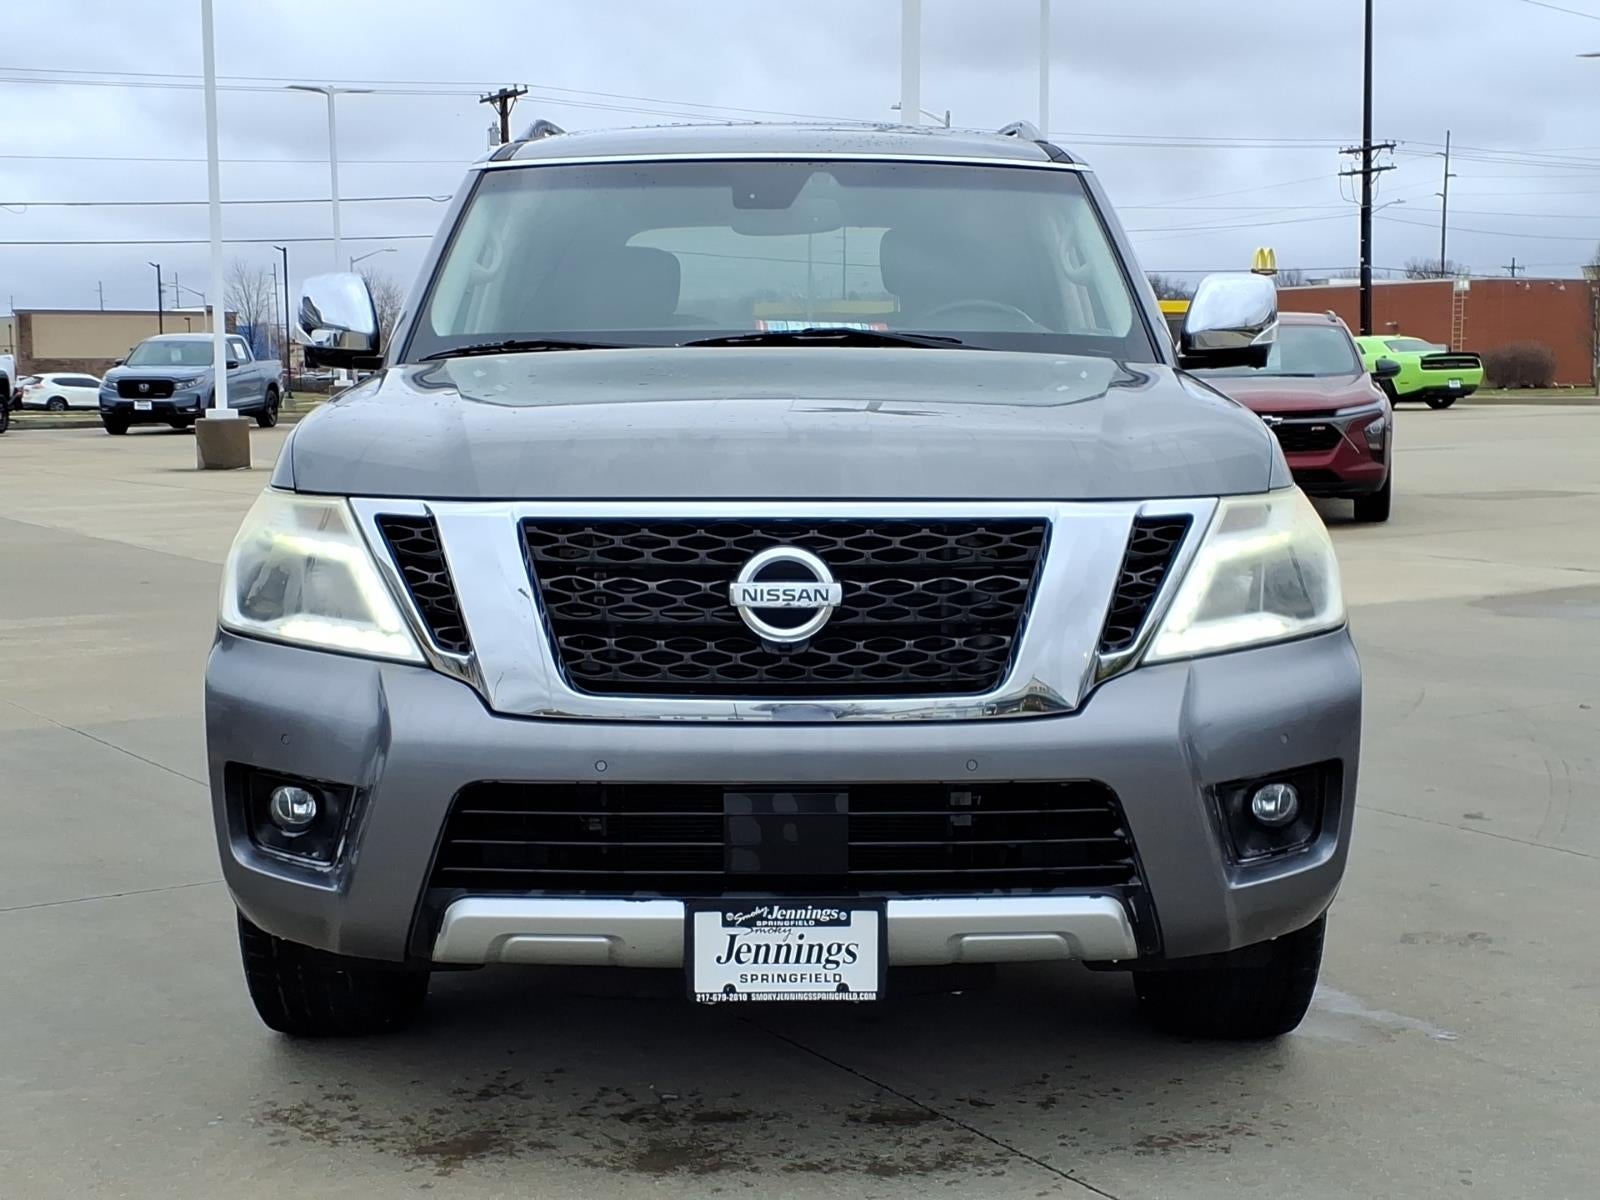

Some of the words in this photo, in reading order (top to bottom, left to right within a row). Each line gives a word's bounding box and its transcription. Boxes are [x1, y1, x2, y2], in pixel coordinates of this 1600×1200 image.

[742, 588, 829, 602] NISSAN
[734, 906, 769, 926] Smoky
[767, 905, 839, 921] Jennings
[715, 933, 859, 970] Jennings
[739, 973, 843, 984] SPRINGFIELD
